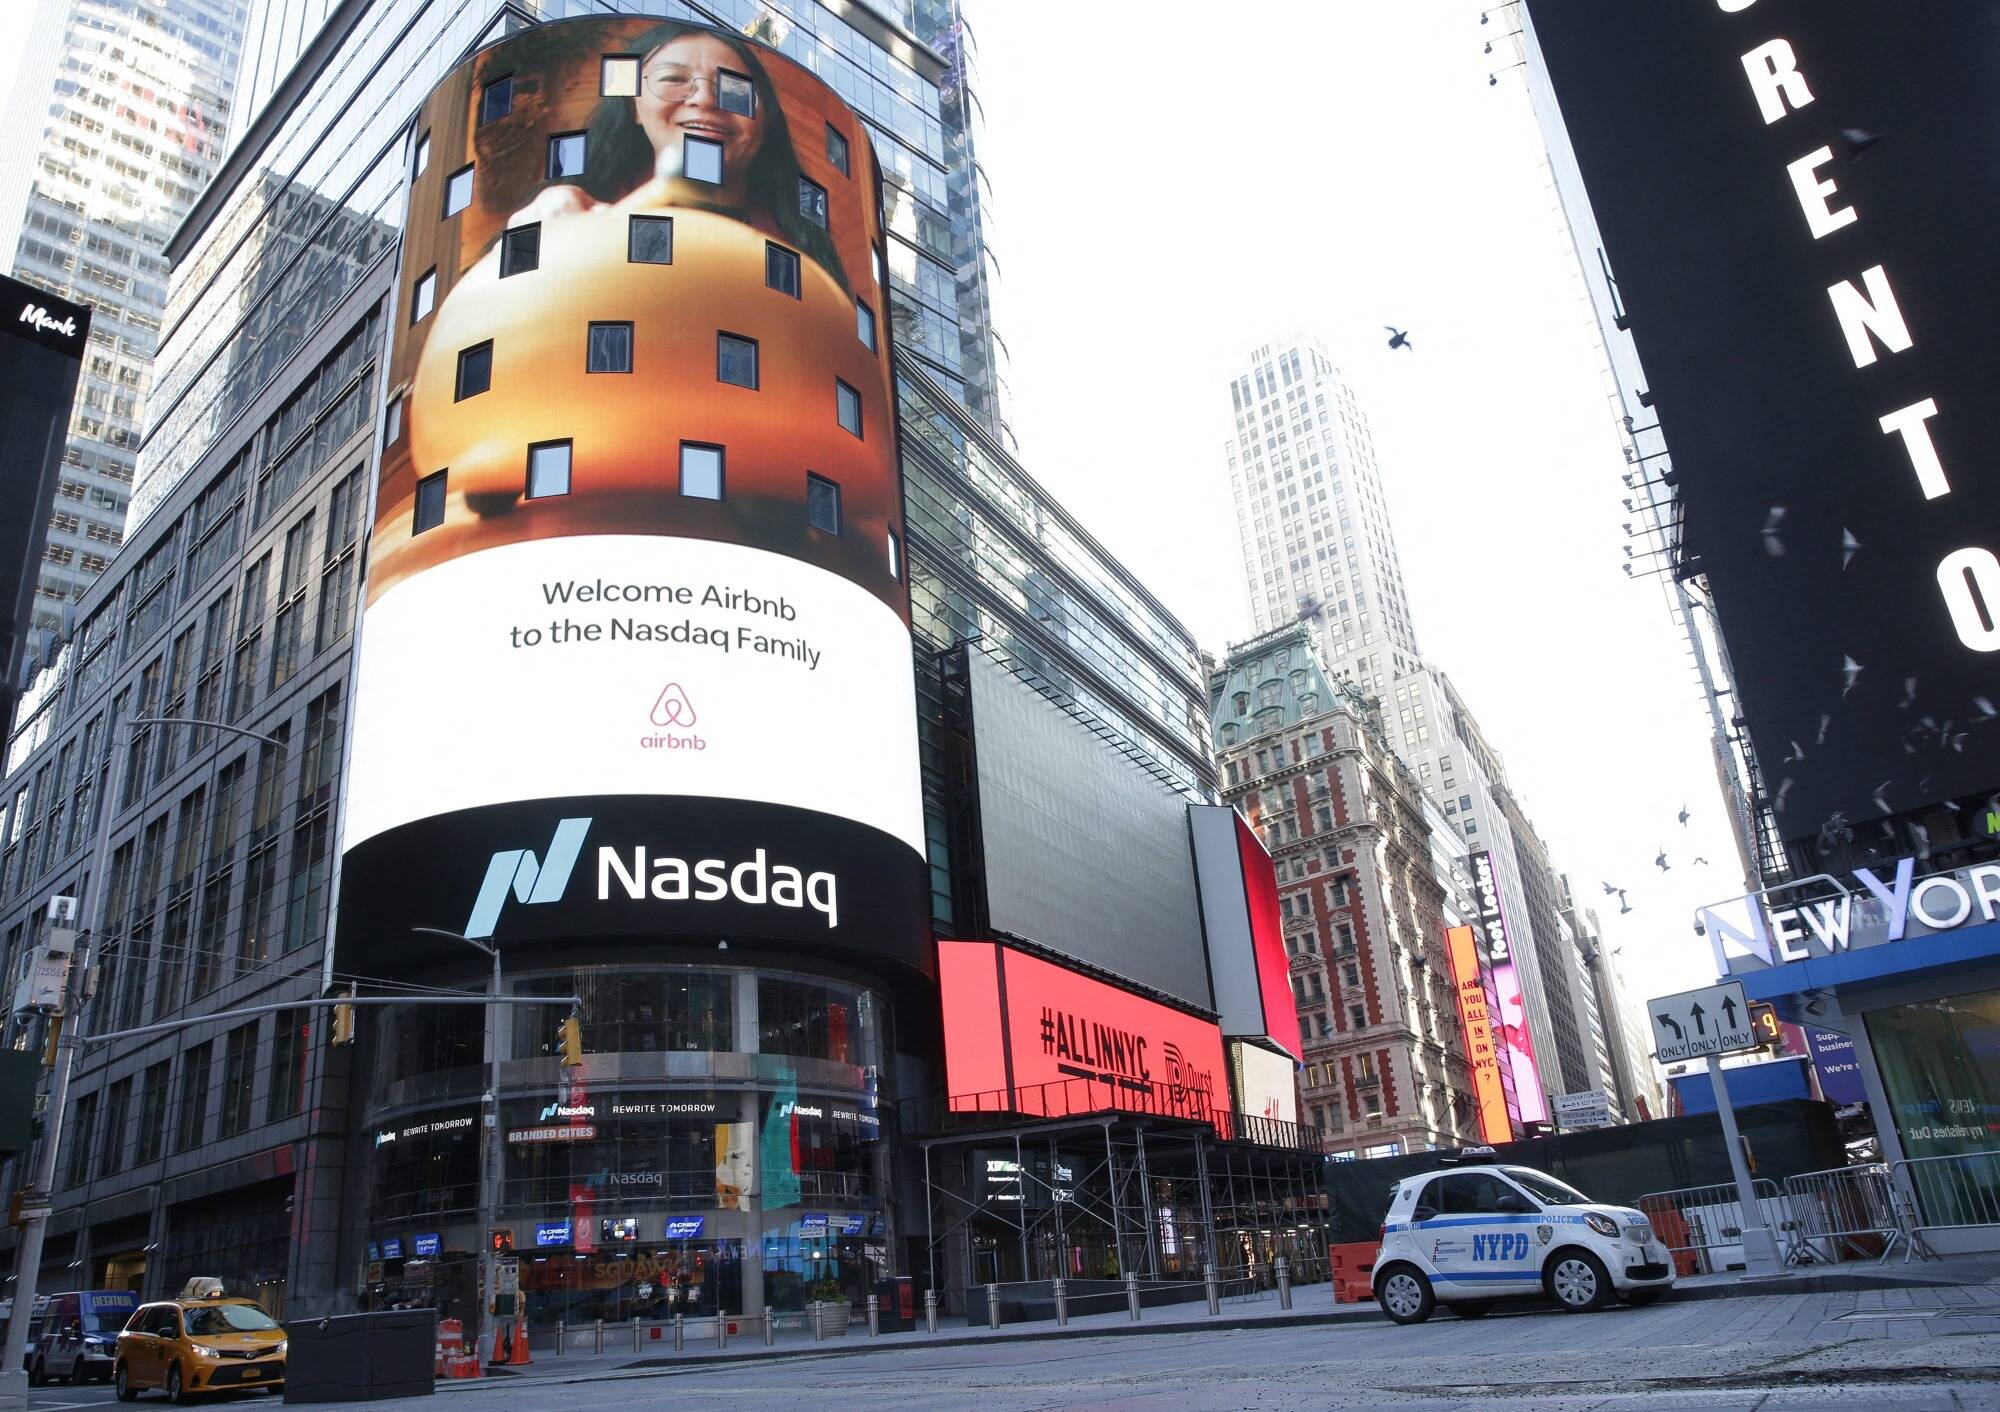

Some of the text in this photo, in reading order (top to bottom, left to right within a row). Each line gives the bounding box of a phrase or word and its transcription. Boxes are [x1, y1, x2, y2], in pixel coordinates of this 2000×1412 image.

[19, 303, 76, 337] Mank
[541, 578, 797, 622] Welcome Airbnb
[510, 618, 822, 671] to the Nasdaq Family
[640, 732, 707, 751] airbnb
[598, 845, 838, 929] Nasdaq
[1701, 892, 1851, 977] NEW
[1464, 995, 1482, 1005] YOU
[1467, 1011, 1485, 1020] ALL
[1474, 1026, 1484, 1037] IN
[1691, 1038, 1717, 1053] ONLY
[1723, 1032, 1750, 1047] ONLY
[1476, 1043, 1488, 1053] ON
[1661, 1044, 1687, 1058] ONLY
[1475, 1058, 1494, 1069] NYC
[1824, 1063, 1853, 1074] We're
[557, 1104, 716, 1116] Nasdaq REWRITE TOMORROW
[794, 1106, 822, 1118] Nasdaq
[833, 1110, 857, 1120] REWRITE
[403, 1125, 428, 1137] REWRITE
[430, 1118, 473, 1131] TOMORROW
[509, 1127, 594, 1142] BRANDED CITIES
[610, 1171, 663, 1185] Nasdaq
[1540, 1215, 1572, 1224] POLICE
[1472, 1233, 1529, 1262] NYPD
